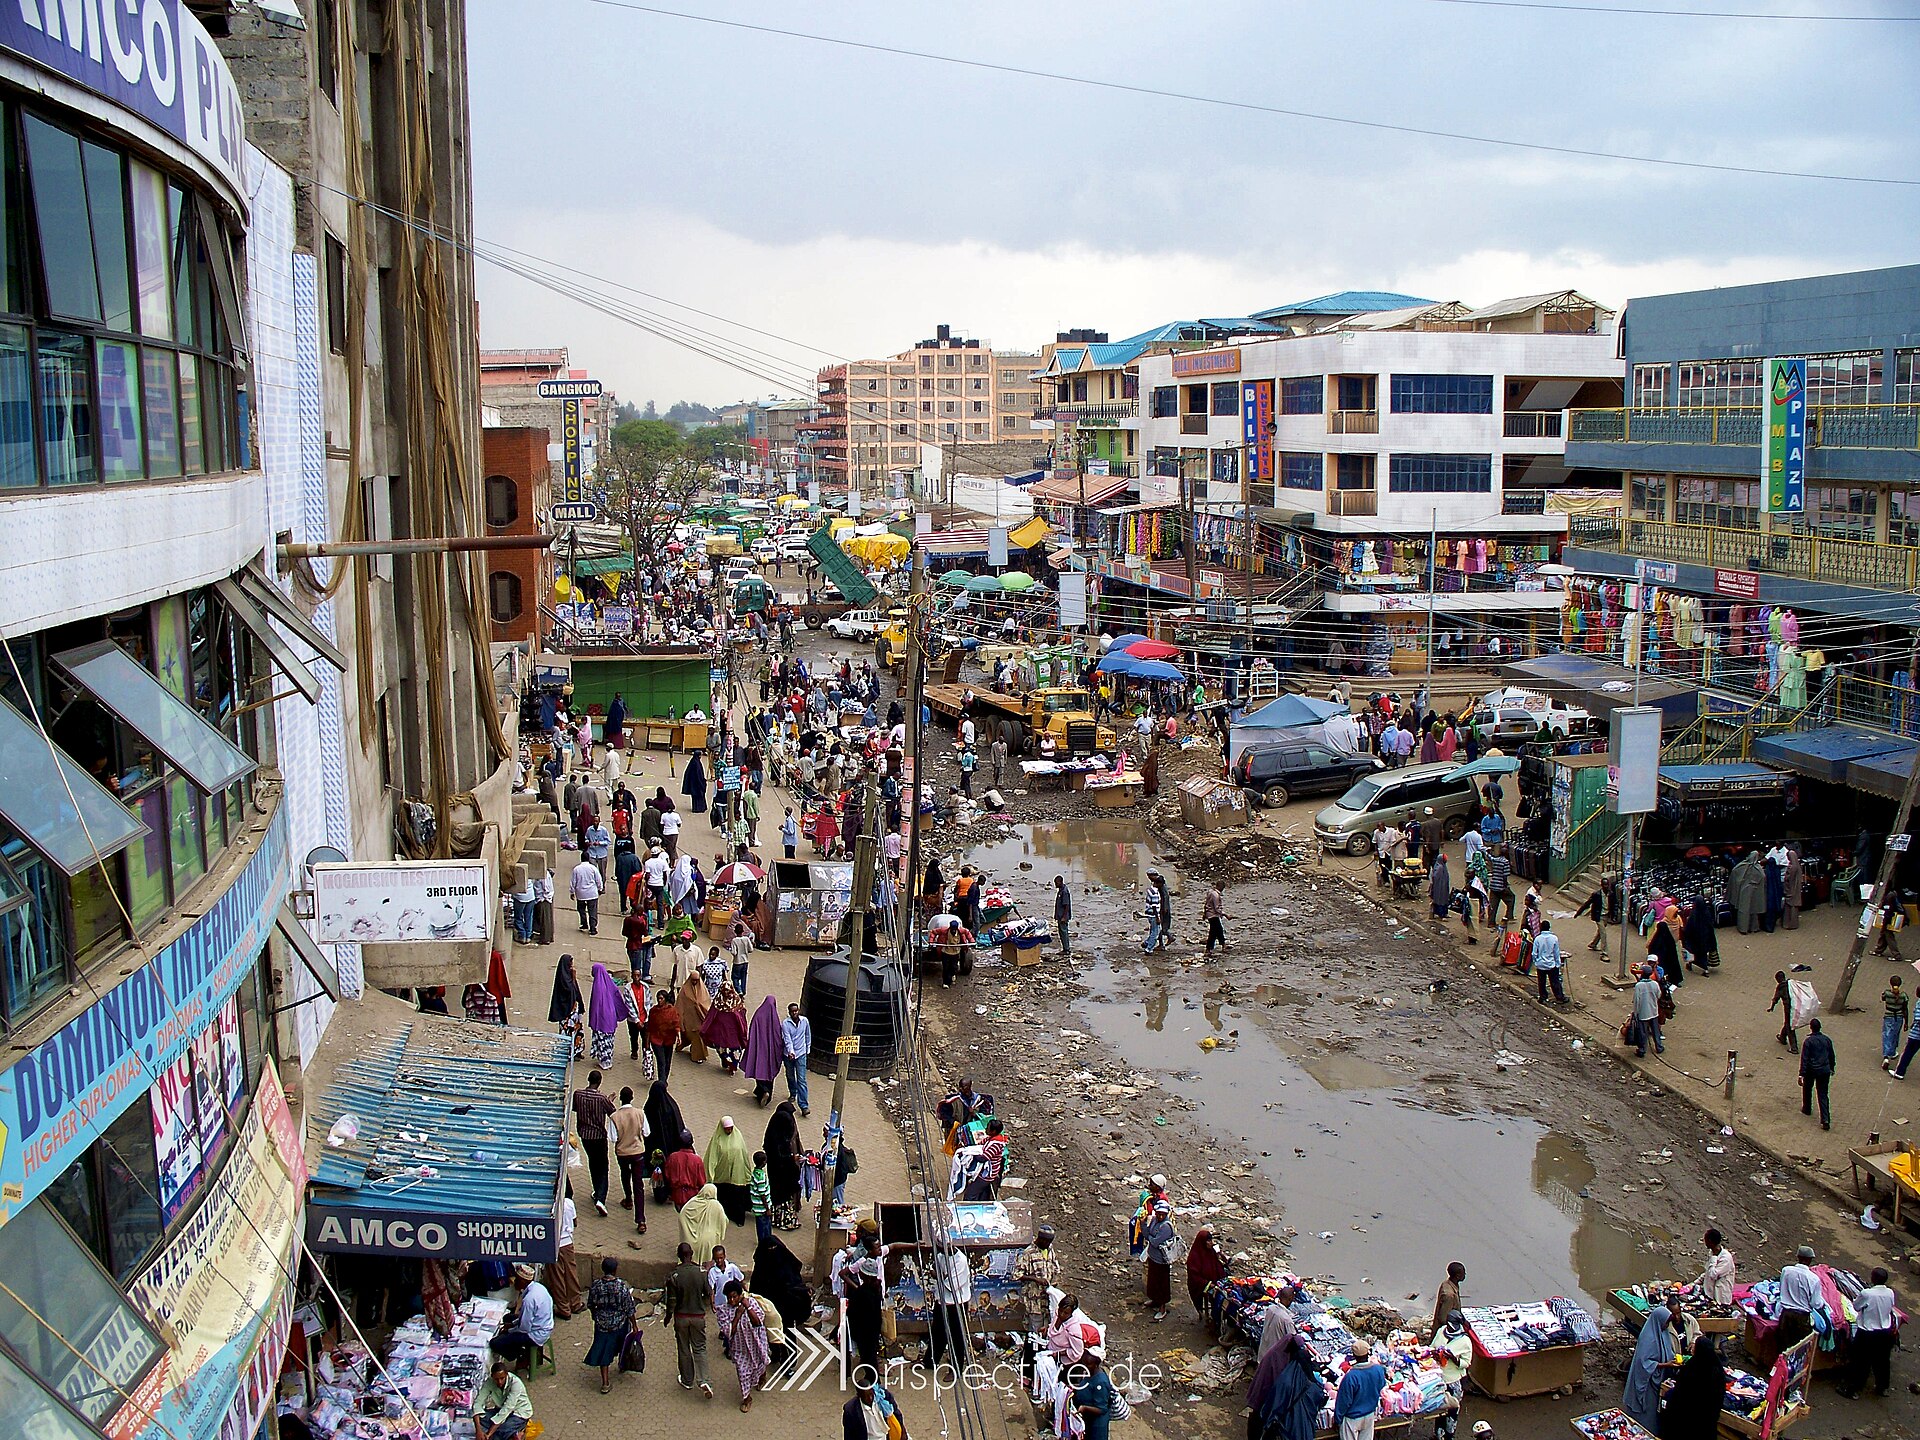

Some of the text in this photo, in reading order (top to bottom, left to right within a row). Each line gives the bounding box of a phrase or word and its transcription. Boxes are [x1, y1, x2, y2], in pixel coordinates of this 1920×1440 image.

[19, 0, 249, 198] MCO PLA
[540, 383, 601, 396] BANGKOK
[565, 400, 579, 501] SHOPPING
[1788, 400, 1803, 508] PLAZA
[555, 507, 592, 518] MALL
[426, 885, 478, 898] 3RD FLOOR
[14, 955, 166, 1142] DOMINION
[171, 845, 269, 1007] INTERNATIONAL
[22, 1118, 77, 1180] HIGHER
[81, 1047, 142, 1126] DIPLOMAS
[156, 991, 203, 1056] DIPLOMAS
[152, 1048, 178, 1080] Your
[317, 1216, 448, 1251] AMCO
[456, 1221, 546, 1240] SHOPPING
[480, 1239, 528, 1257] MALL
[172, 1283, 205, 1354] PRIMARY
